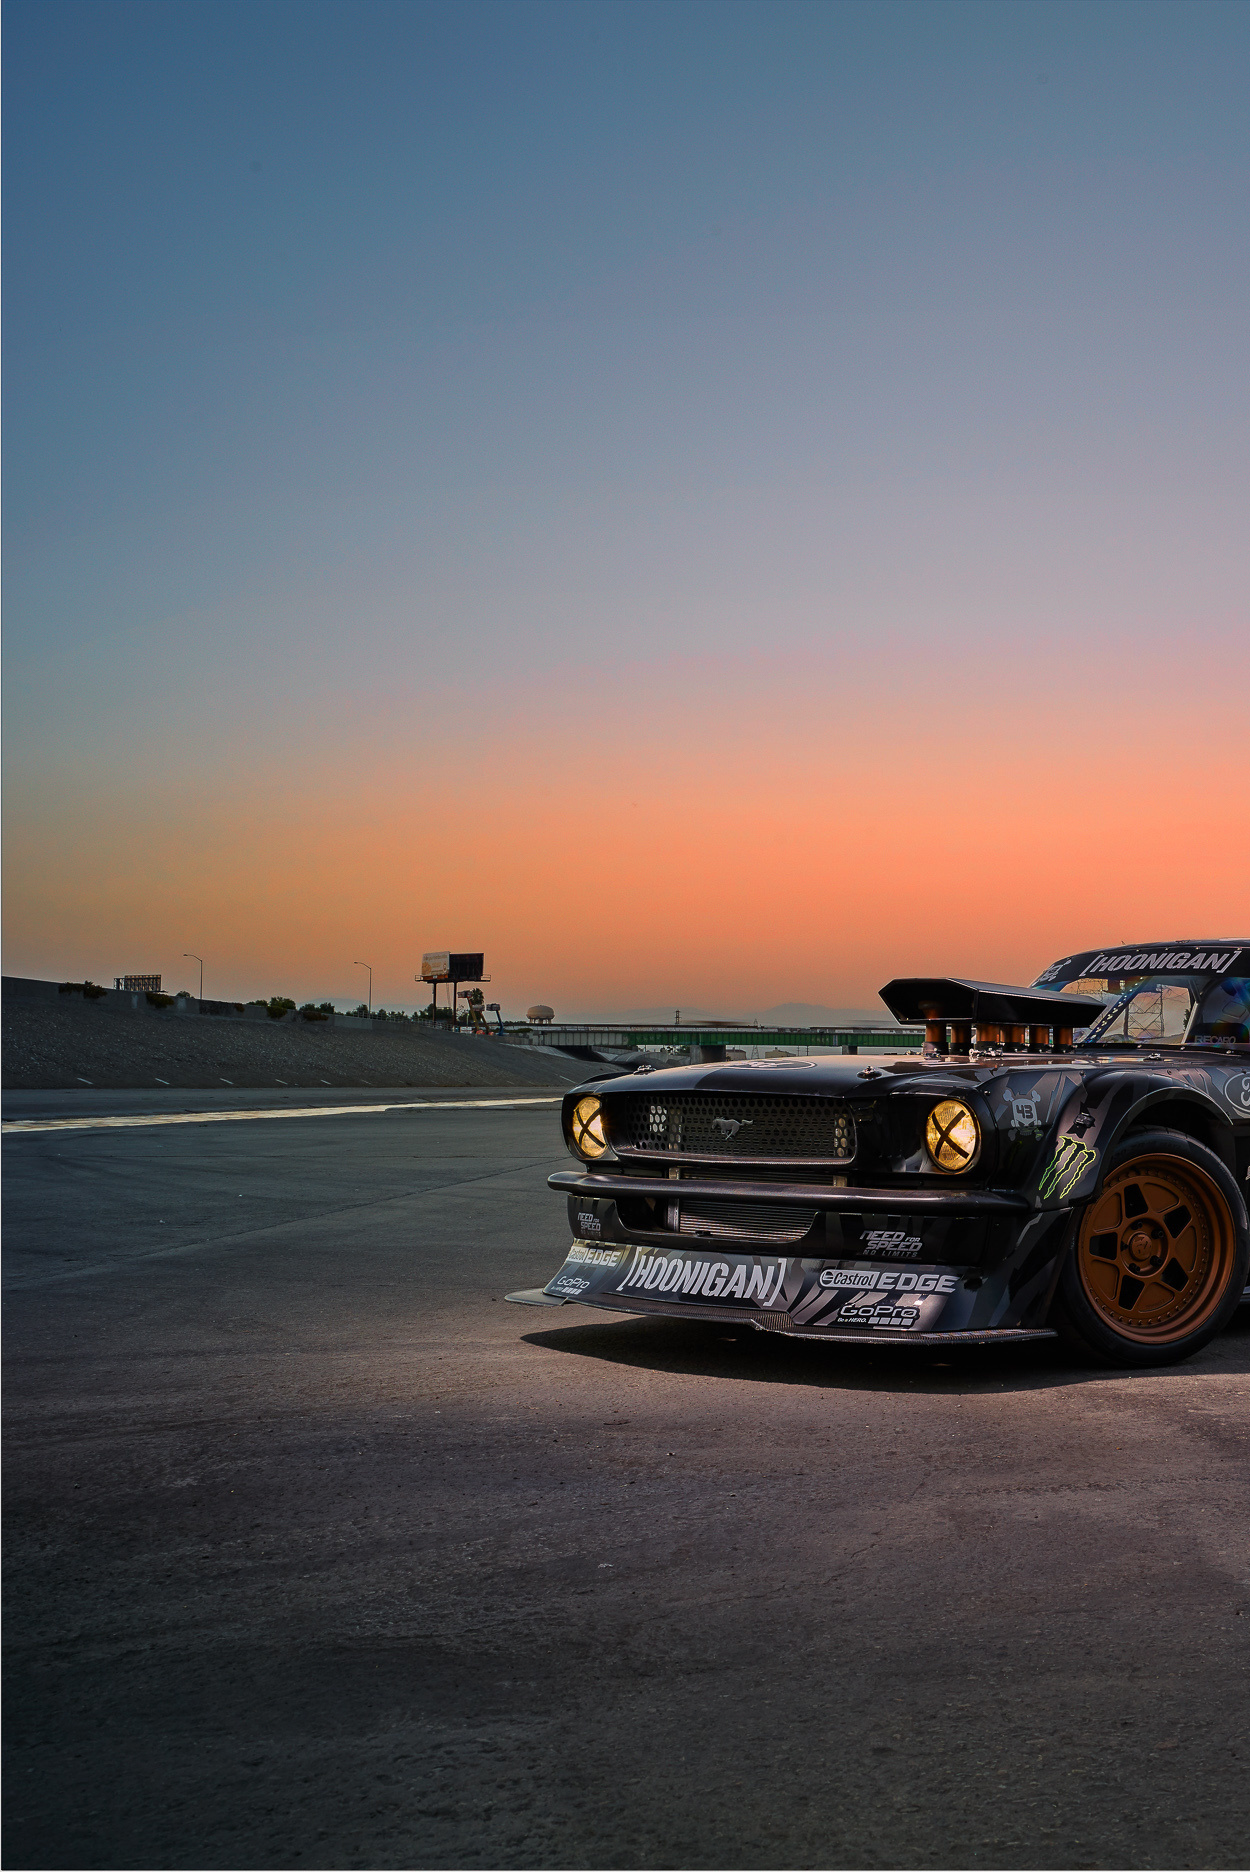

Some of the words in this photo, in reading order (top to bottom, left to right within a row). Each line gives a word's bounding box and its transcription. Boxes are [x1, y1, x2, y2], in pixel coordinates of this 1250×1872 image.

[1079, 950, 1242, 977] [HOONIGAN]
[1194, 1034, 1236, 1044] RECARO
[1015, 1105, 1034, 1119] 43
[577, 1212, 594, 1223] NEED
[580, 1221, 601, 1232] SPEED
[859, 1230, 906, 1242] NEED
[865, 1240, 923, 1252] SPEED
[584, 1248, 621, 1268] EDGE
[881, 1250, 918, 1258] LIMITS
[557, 1275, 590, 1289] GoPro
[616, 1246, 788, 1307] [HOONIGAN]
[833, 1271, 876, 1288] Castrol
[876, 1272, 961, 1294] EDGE
[840, 1305, 918, 1318] GoPro
